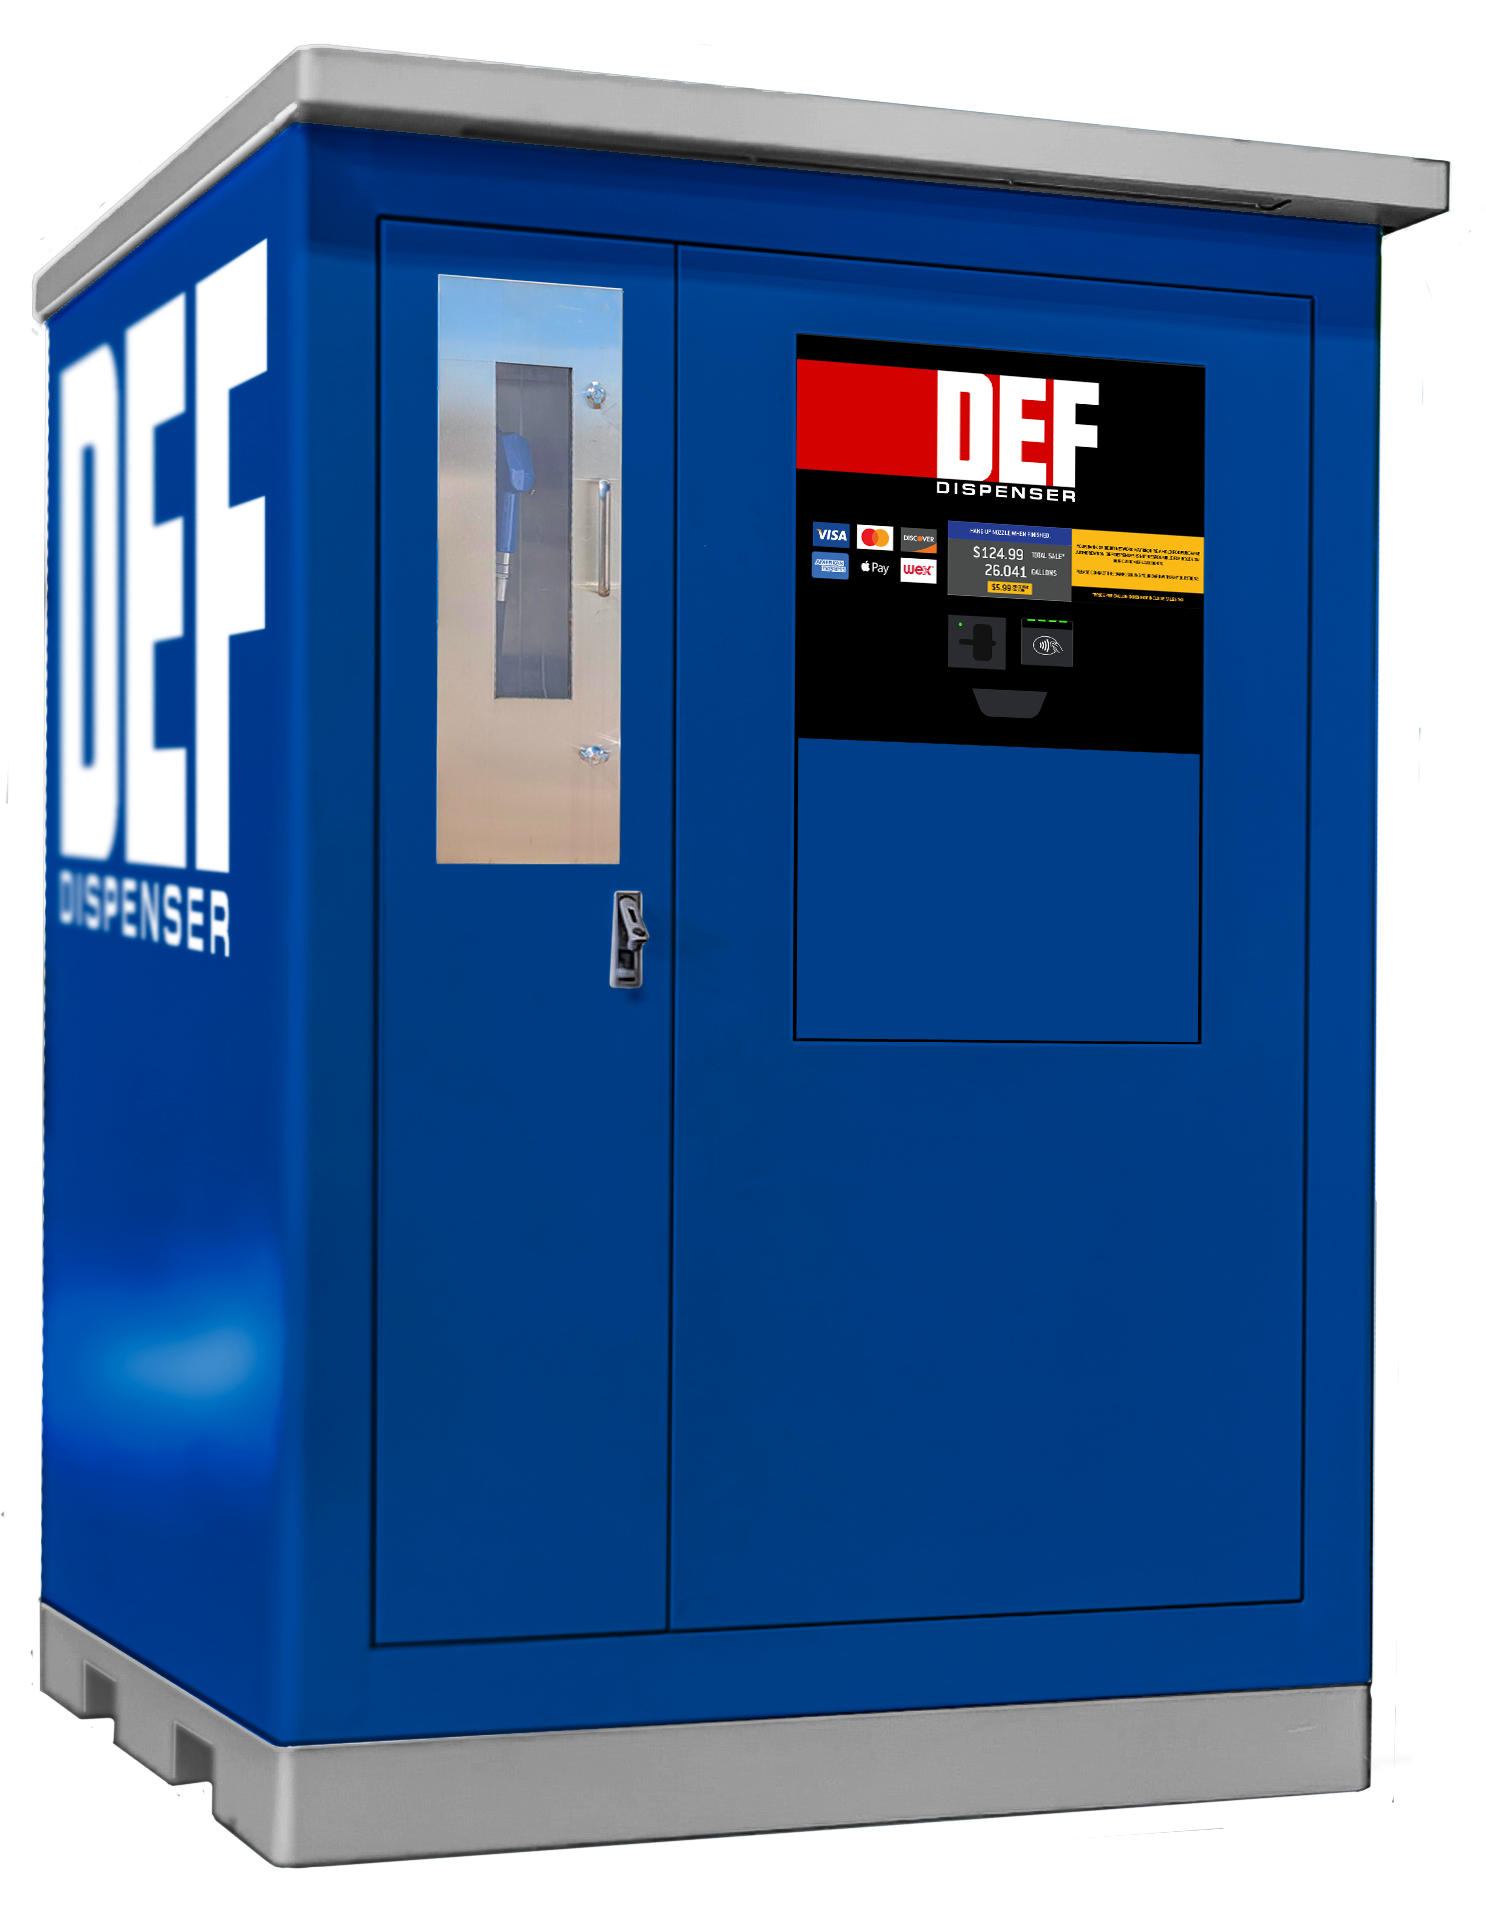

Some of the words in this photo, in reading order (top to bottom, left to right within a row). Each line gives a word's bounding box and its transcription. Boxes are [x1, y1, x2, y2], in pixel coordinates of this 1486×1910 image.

[937, 370, 1099, 488] DEF
[936, 481, 1076, 502] DISPENSER
[816, 529, 847, 541] VISA
[60, 238, 267, 873] DEF
[973, 545, 1024, 561] $124.99
[872, 562, 889, 576] Pay
[985, 564, 1027, 578] 26.041
[59, 868, 230, 958] DISPENSER
